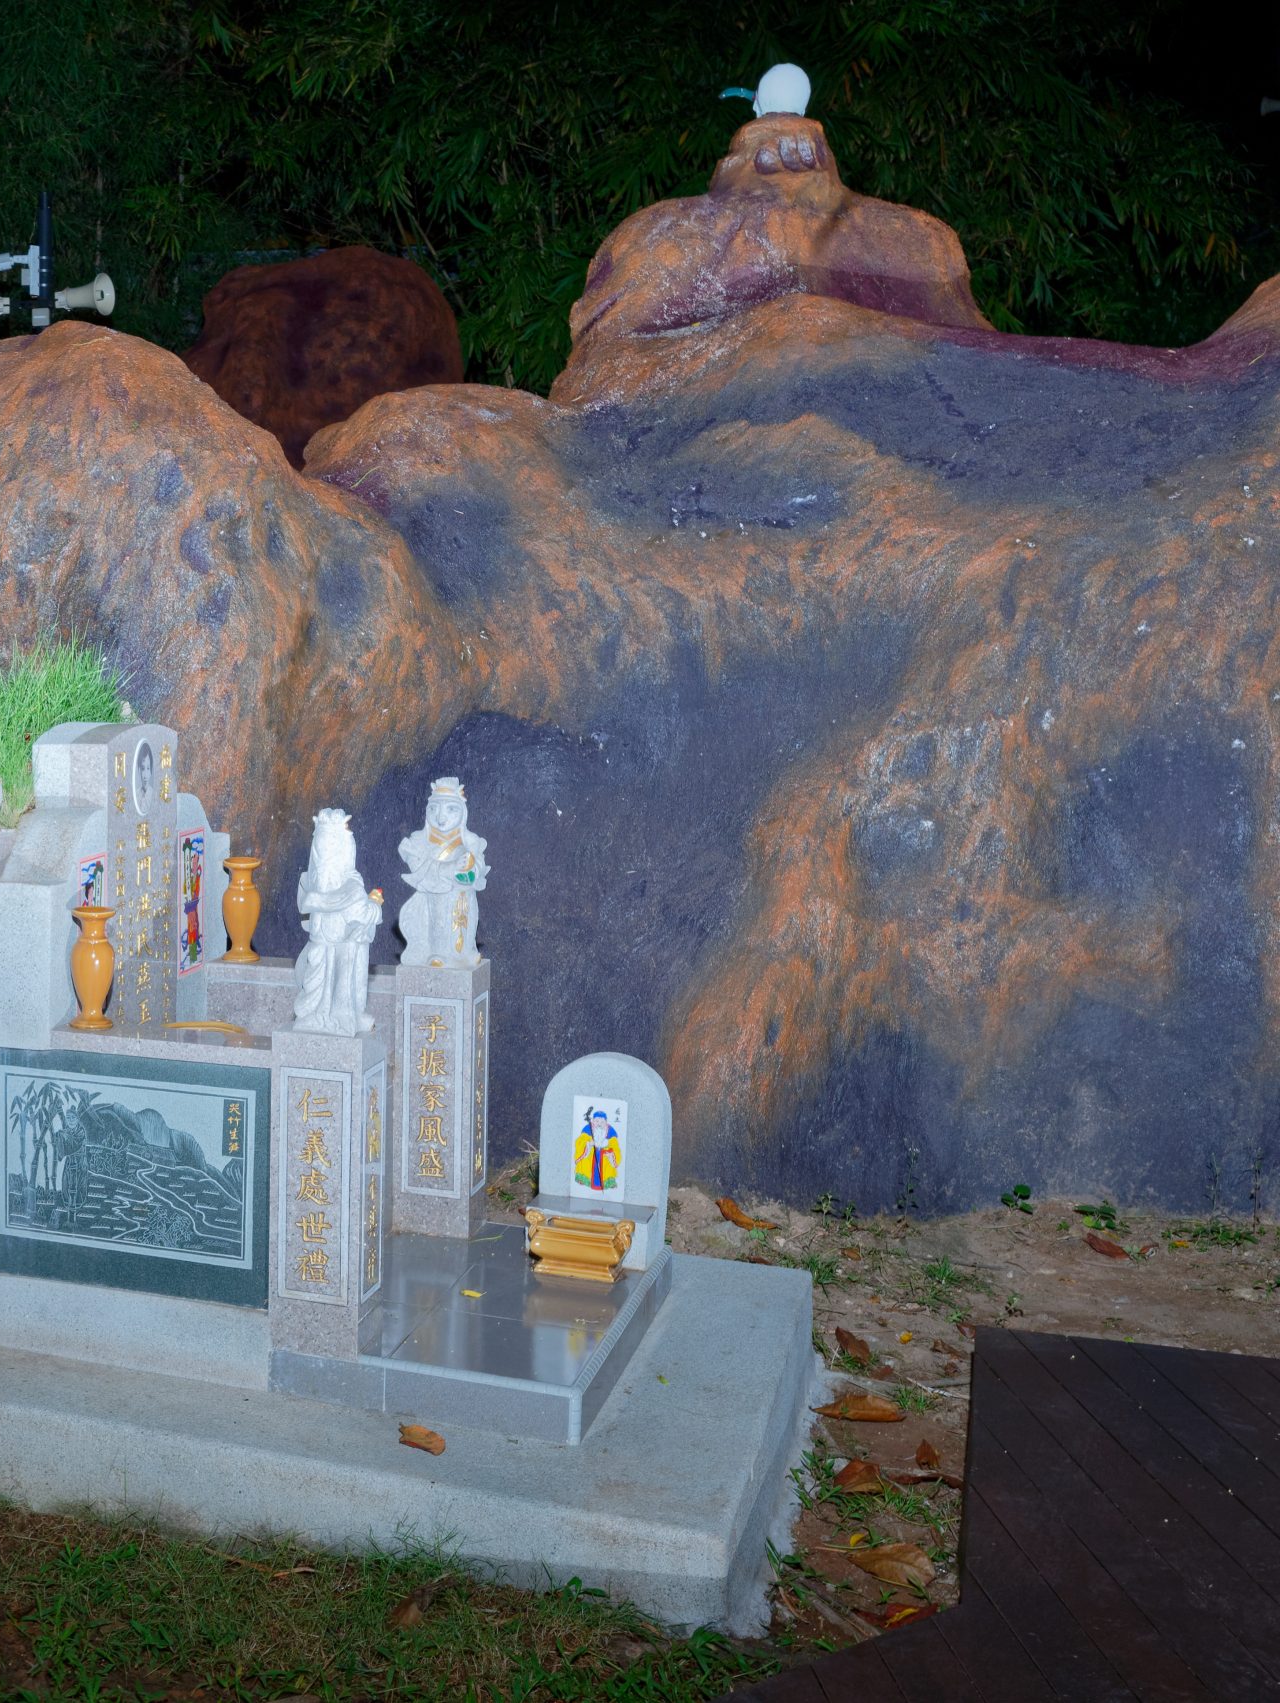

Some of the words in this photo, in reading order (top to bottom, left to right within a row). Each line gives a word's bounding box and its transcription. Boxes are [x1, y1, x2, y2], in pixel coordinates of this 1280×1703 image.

[415, 1014, 448, 1178] 子振家風盛
[295, 1088, 334, 1285] 仁義處世禮
